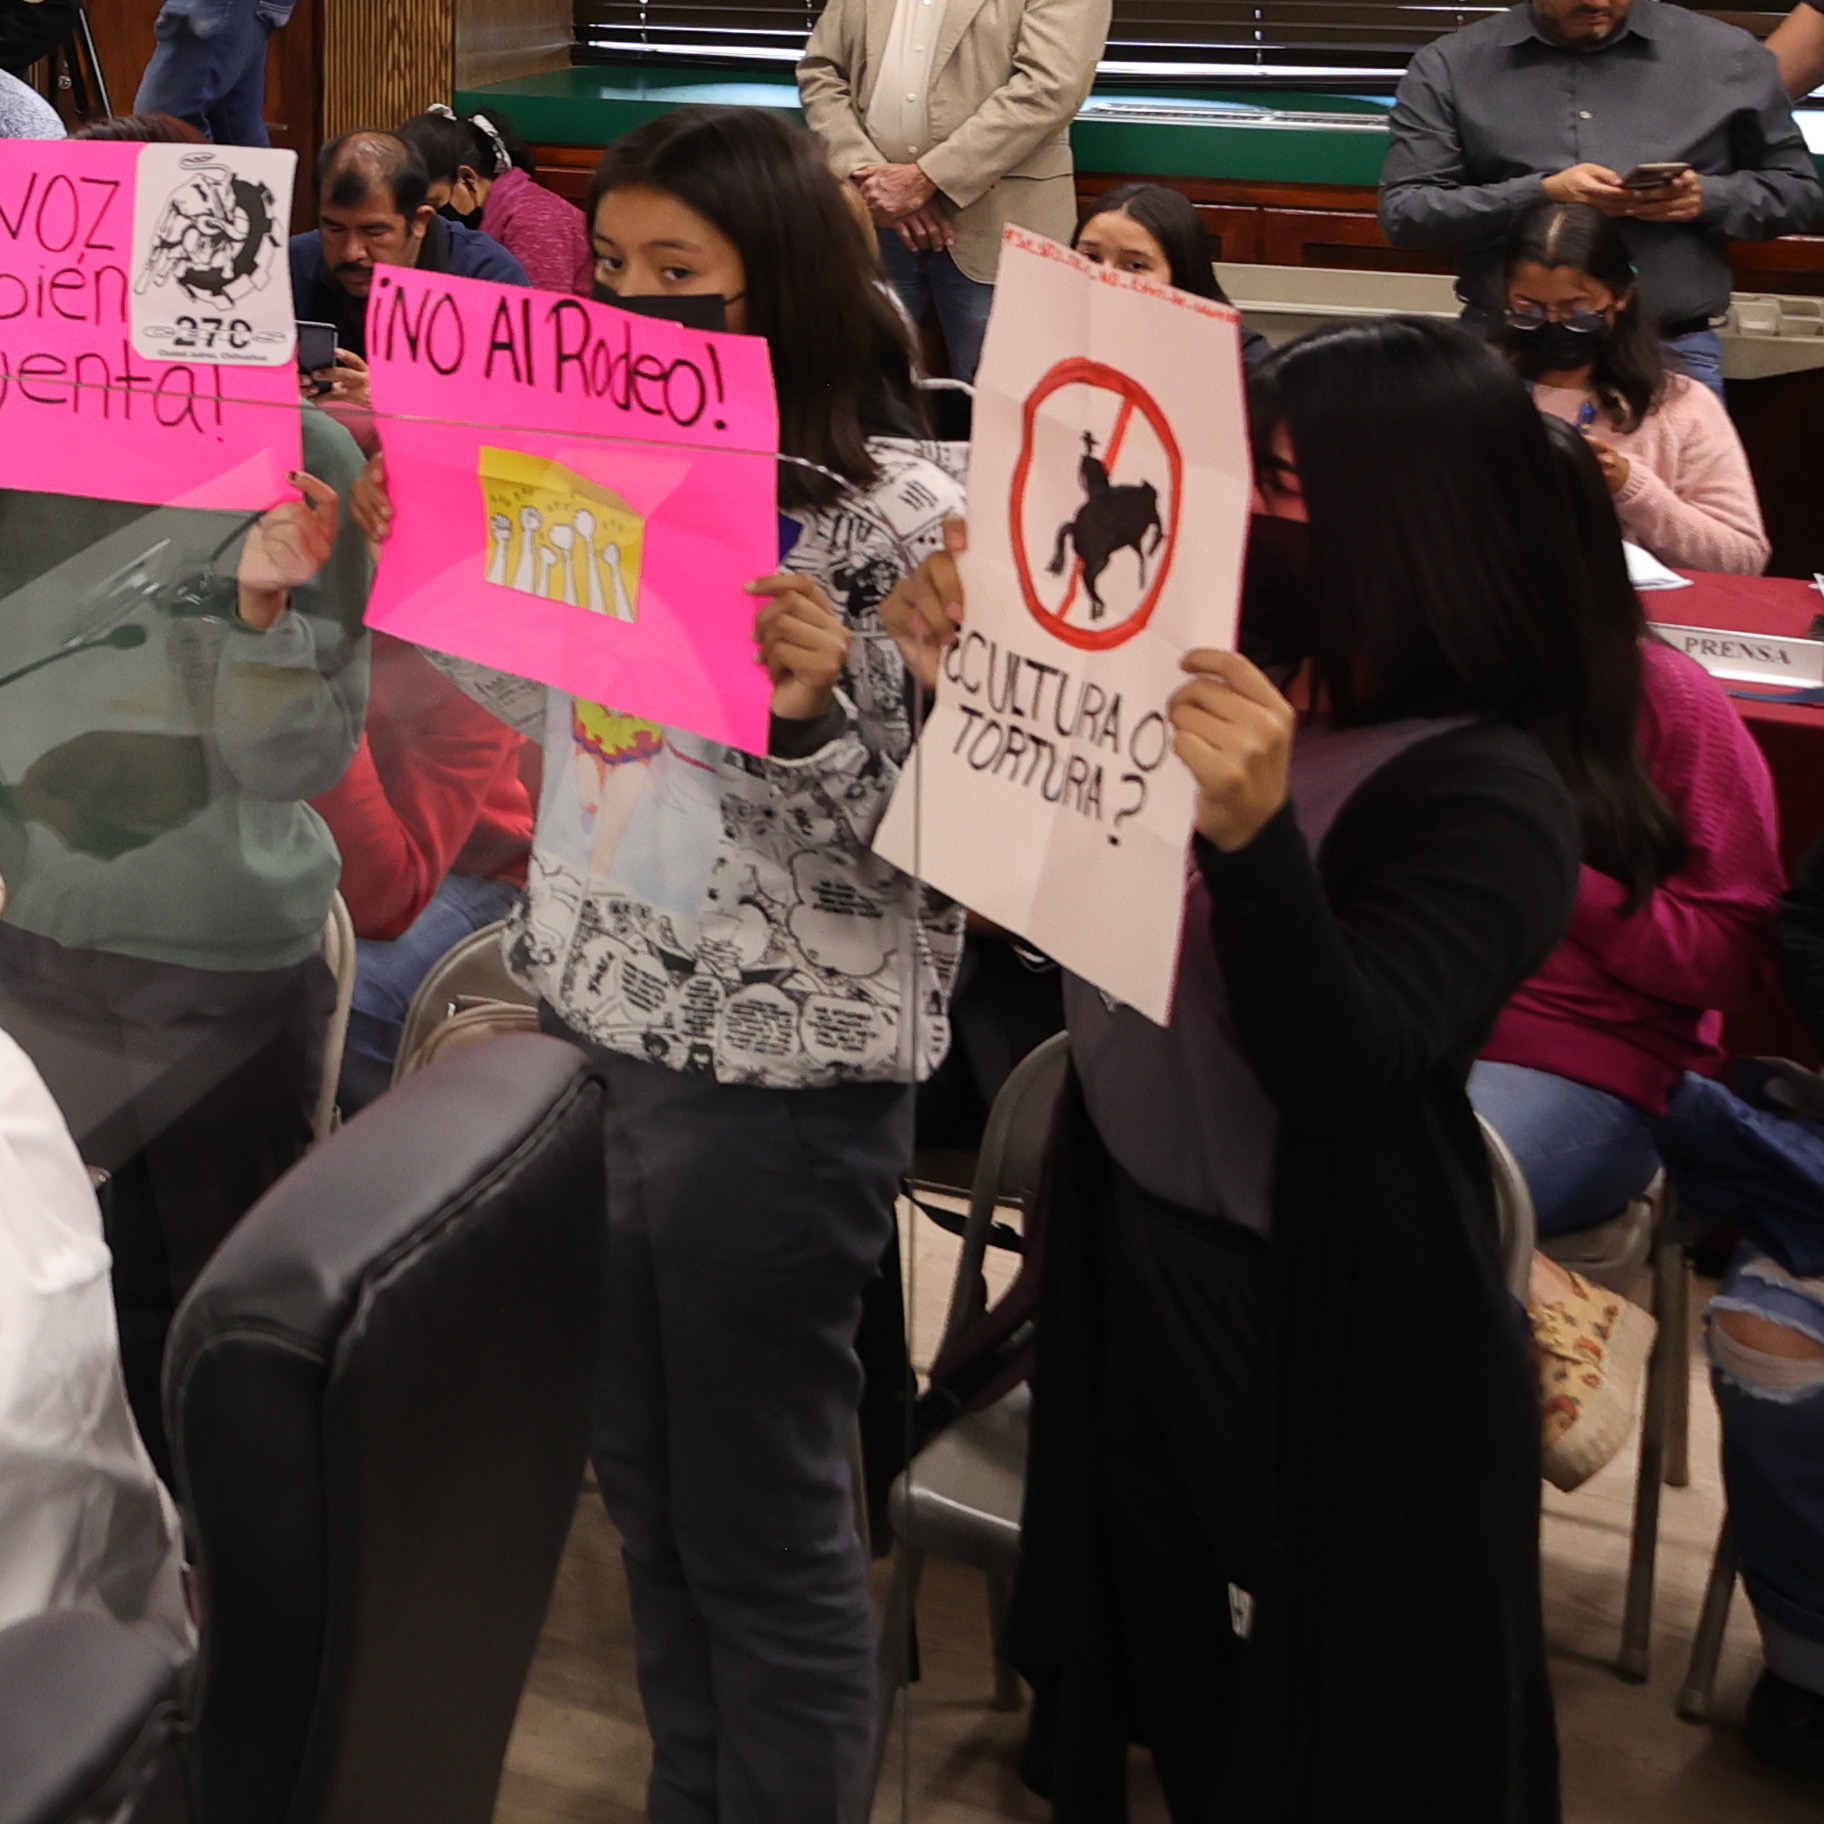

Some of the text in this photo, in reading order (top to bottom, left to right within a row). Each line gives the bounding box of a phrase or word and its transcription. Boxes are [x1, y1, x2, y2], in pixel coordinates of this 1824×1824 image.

[545, 299, 728, 432] Rodeo!
[943, 623, 1167, 772] ¿CULTURA O
[1684, 636, 1792, 665] PRENSA
